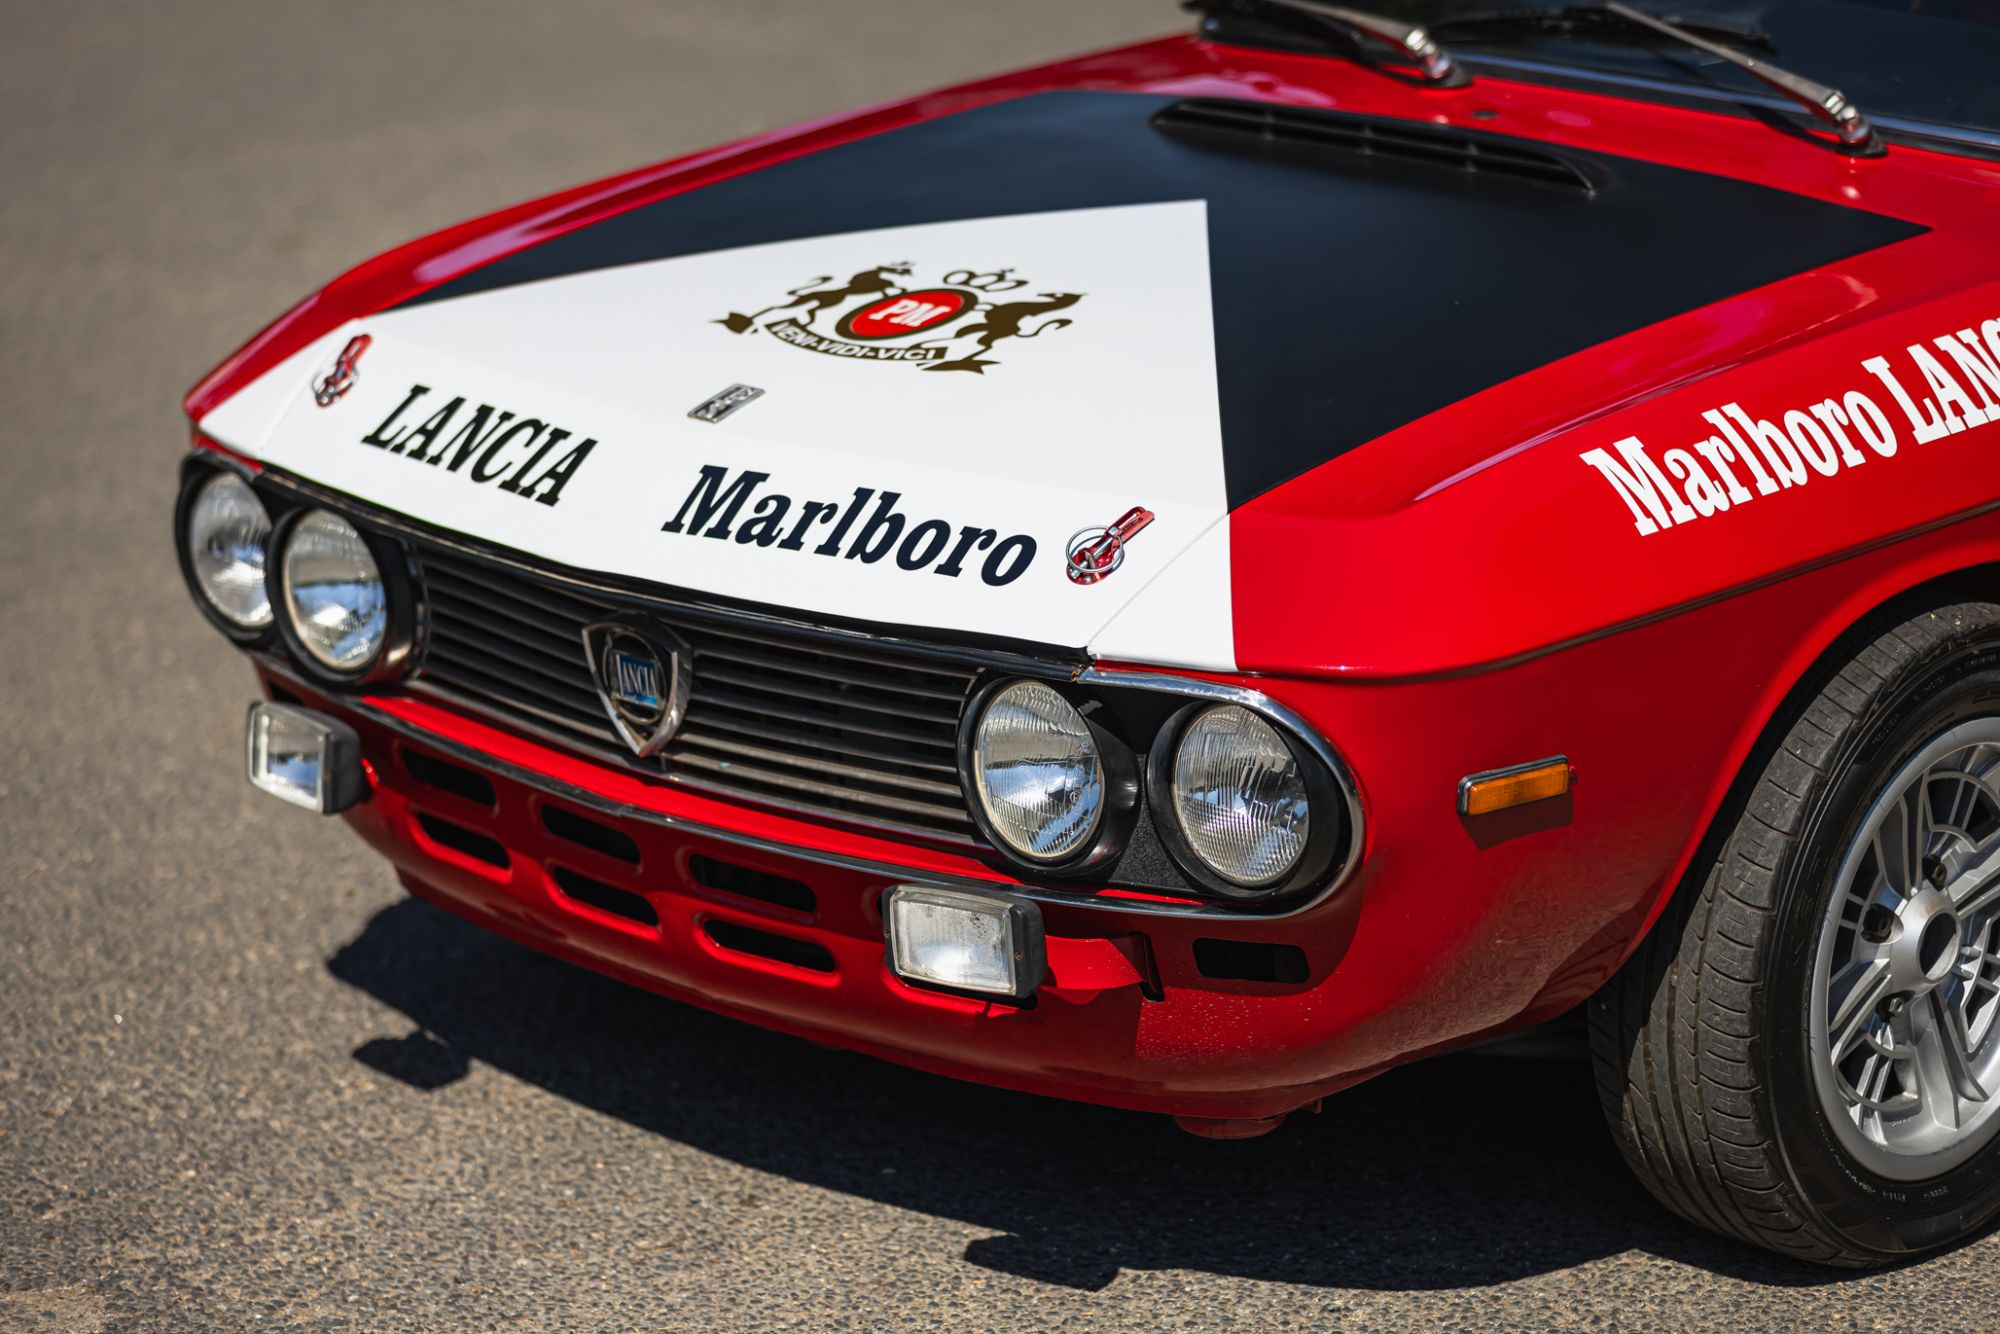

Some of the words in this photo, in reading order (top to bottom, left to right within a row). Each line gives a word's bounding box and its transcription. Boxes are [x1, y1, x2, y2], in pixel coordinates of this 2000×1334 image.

[868, 298, 953, 328] PM
[361, 384, 598, 507] LANCIA
[1580, 391, 1898, 537] Marlboro
[660, 464, 1038, 588] Marlboro
[614, 652, 659, 700] LANCIA
